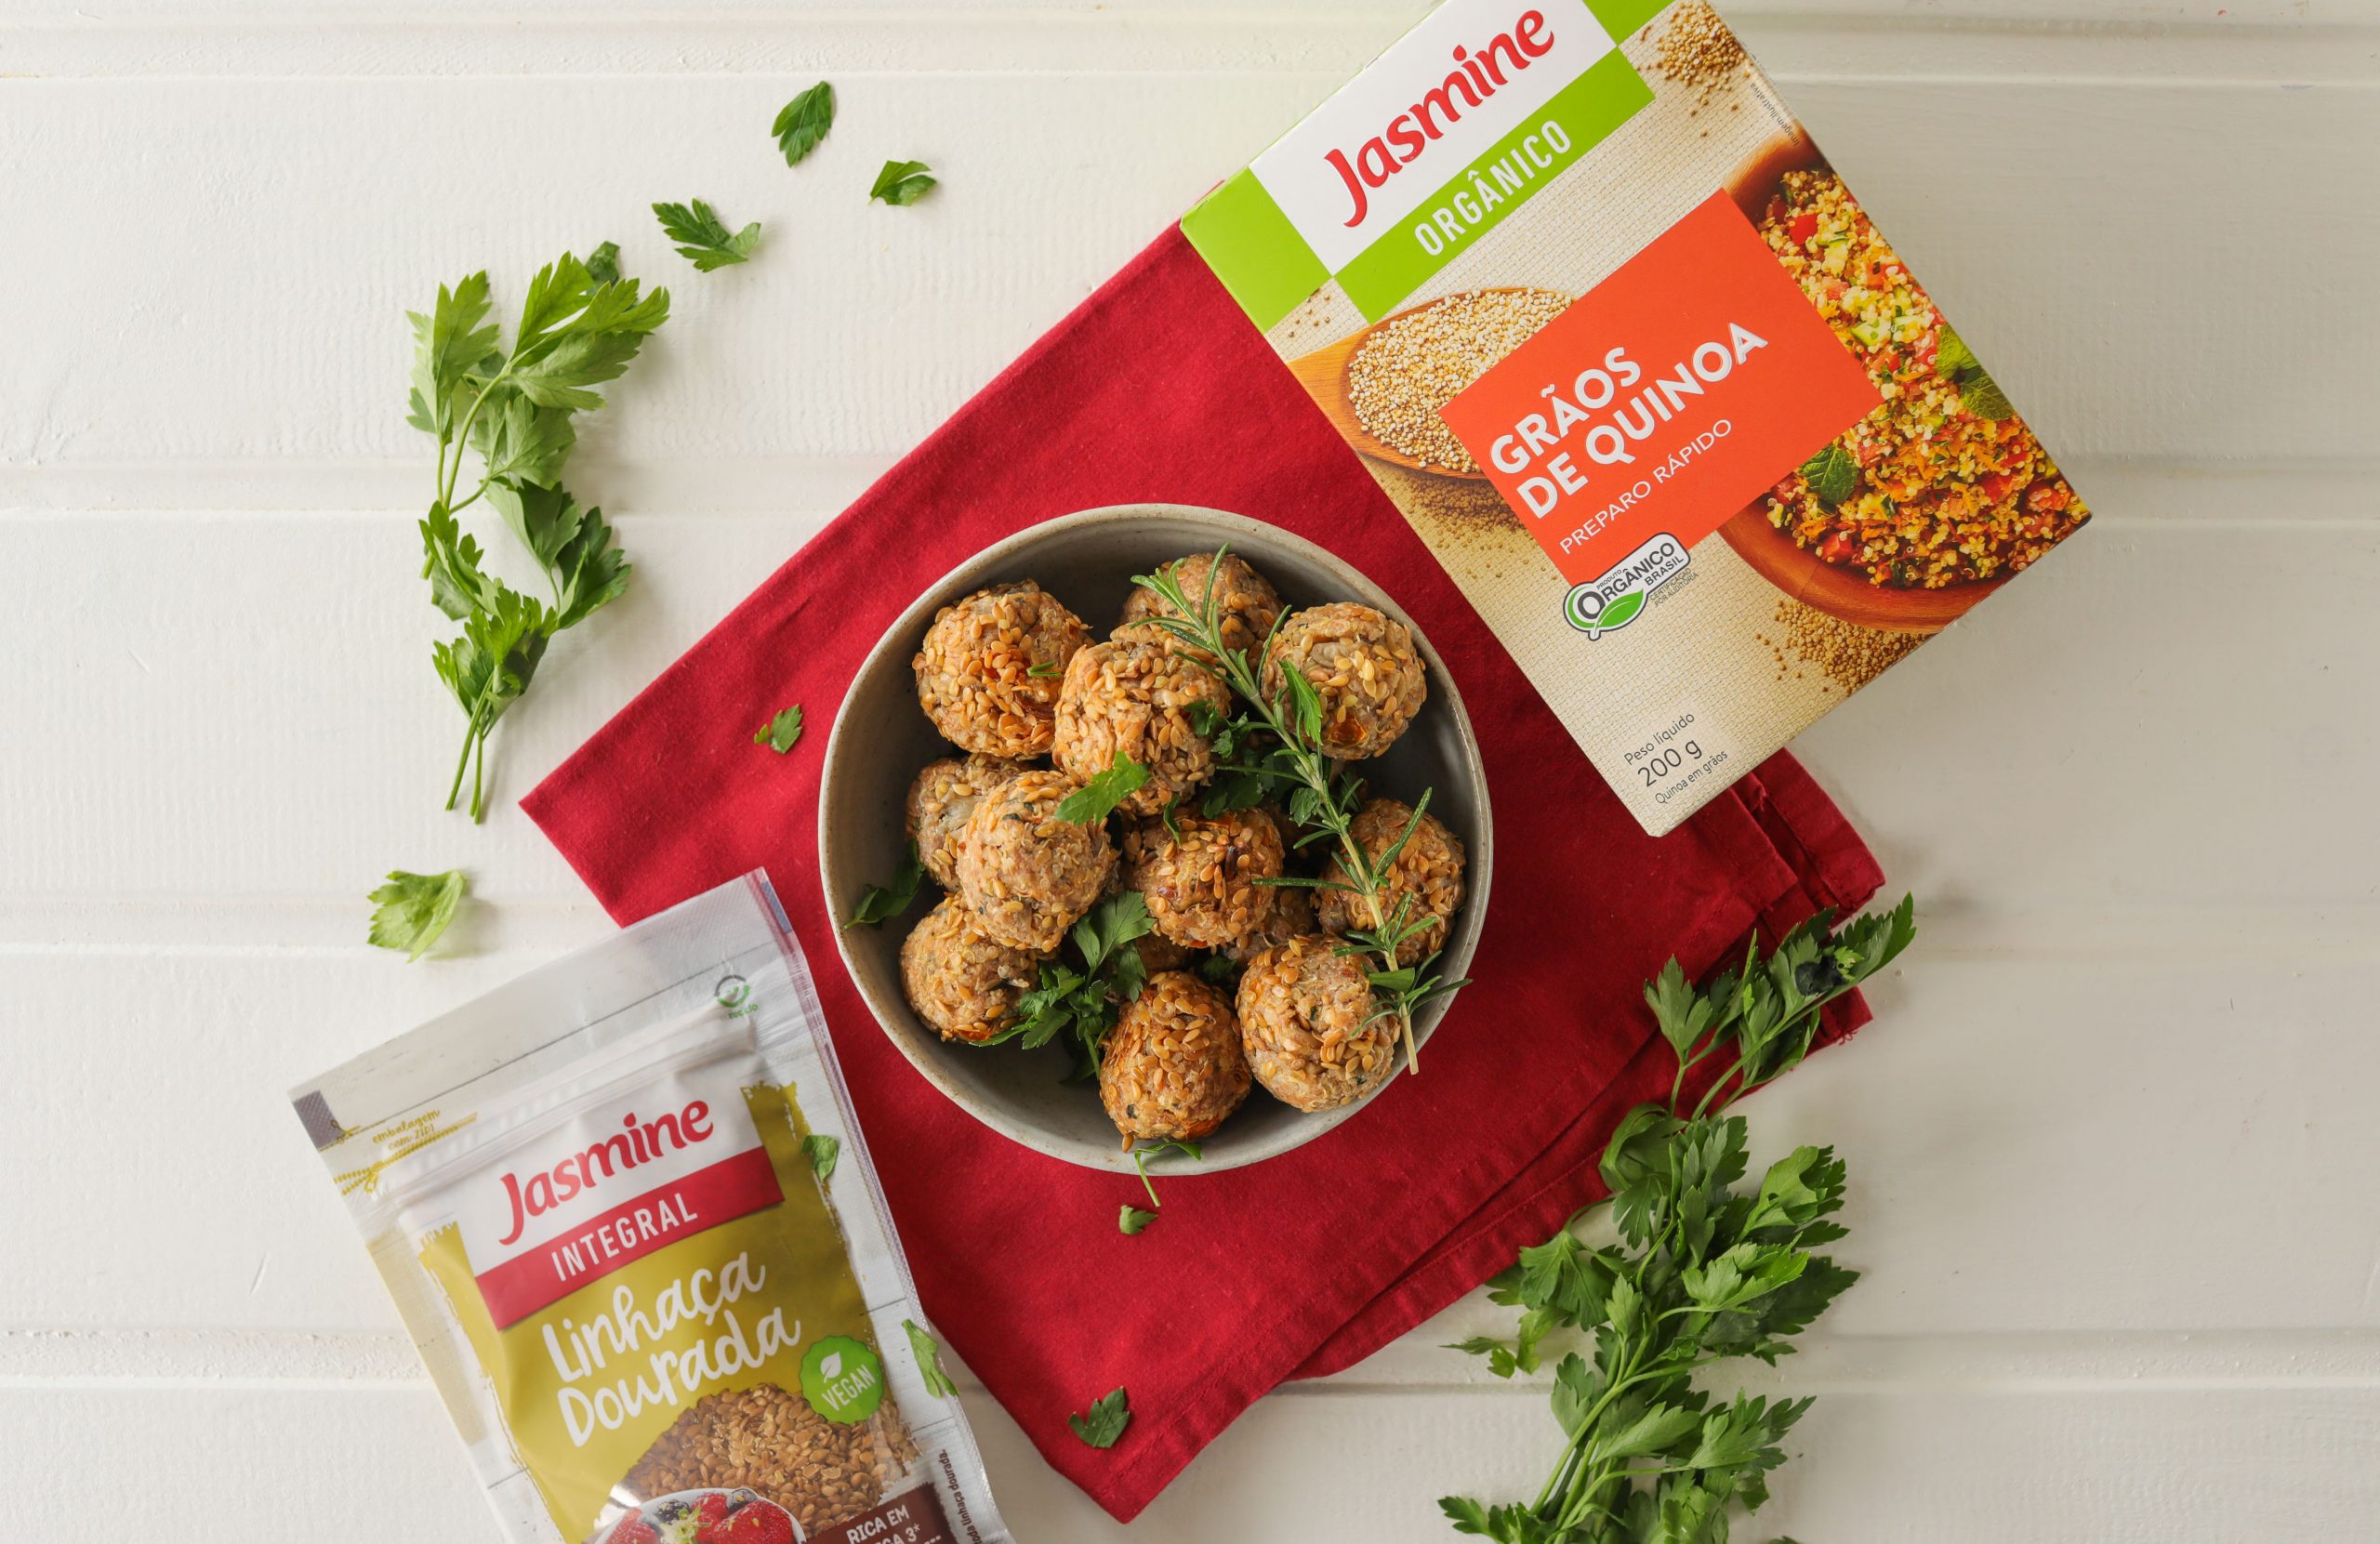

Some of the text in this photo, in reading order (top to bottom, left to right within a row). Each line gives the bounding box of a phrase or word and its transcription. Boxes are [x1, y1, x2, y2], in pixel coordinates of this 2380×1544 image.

[1323, 9, 1554, 228] Jasmine
[1414, 119, 1571, 256] ORGÂNICO
[1490, 346, 1641, 474] GRÃOS
[1516, 322, 1768, 519] DE QUINOA
[1559, 418, 1732, 554] PREPARO RÁPIDO
[1577, 542, 1675, 620] ORGÂNICO
[1596, 569, 1622, 589] PRODUTO
[1644, 555, 1685, 587] BRASIL
[1623, 714, 1695, 766] Peso líquido
[1637, 739, 1702, 787] 200 g
[1655, 750, 1727, 804] Quinoa em grãos
[372, 1109, 441, 1144] embalagem
[498, 1100, 714, 1247] Jasmine
[551, 1193, 697, 1282] INTEGRAL
[542, 1251, 766, 1383] Linhaça
[558, 1307, 801, 1447] Dourada
[821, 1364, 876, 1411] VEGAN
[938, 1448, 959, 1491] dourada.
[846, 1516, 887, 1544] RICA
[886, 1504, 910, 1527] EM
[953, 1491, 972, 1526] linhaça
